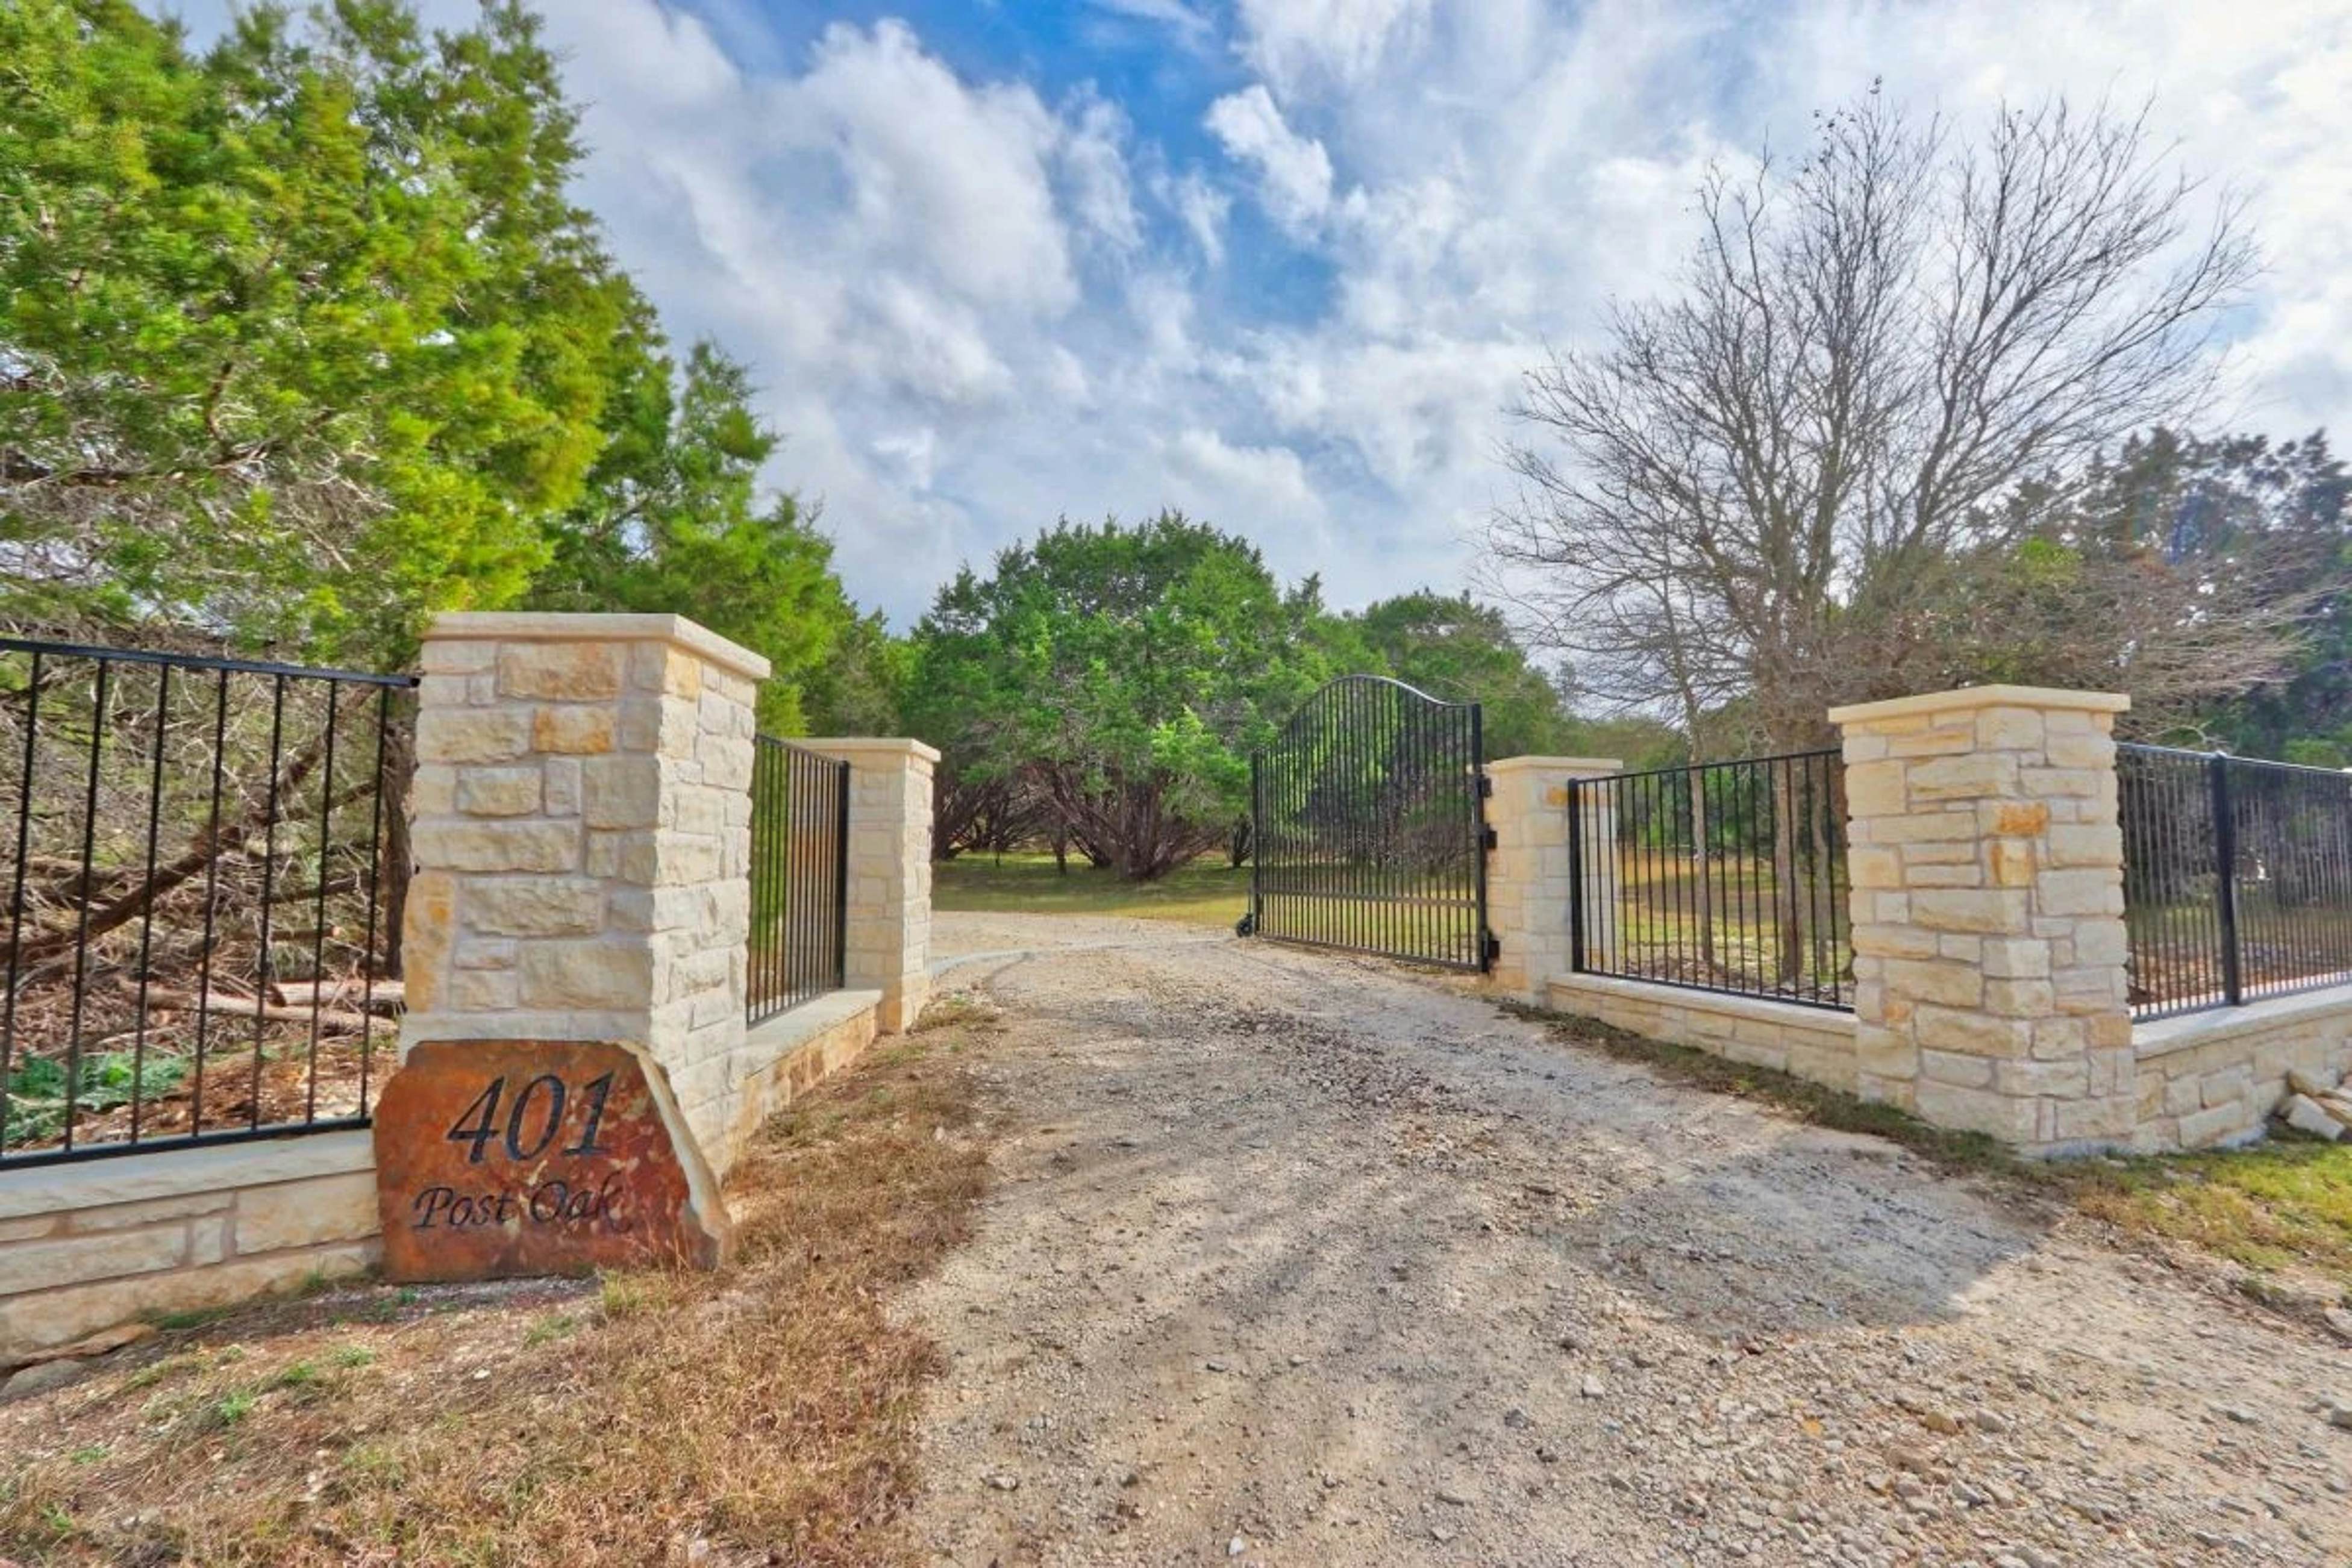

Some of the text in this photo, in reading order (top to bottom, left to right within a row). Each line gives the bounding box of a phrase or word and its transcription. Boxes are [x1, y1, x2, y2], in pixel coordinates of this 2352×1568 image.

[447, 1070, 615, 1163] 401
[413, 1171, 634, 1232] Post Oak
